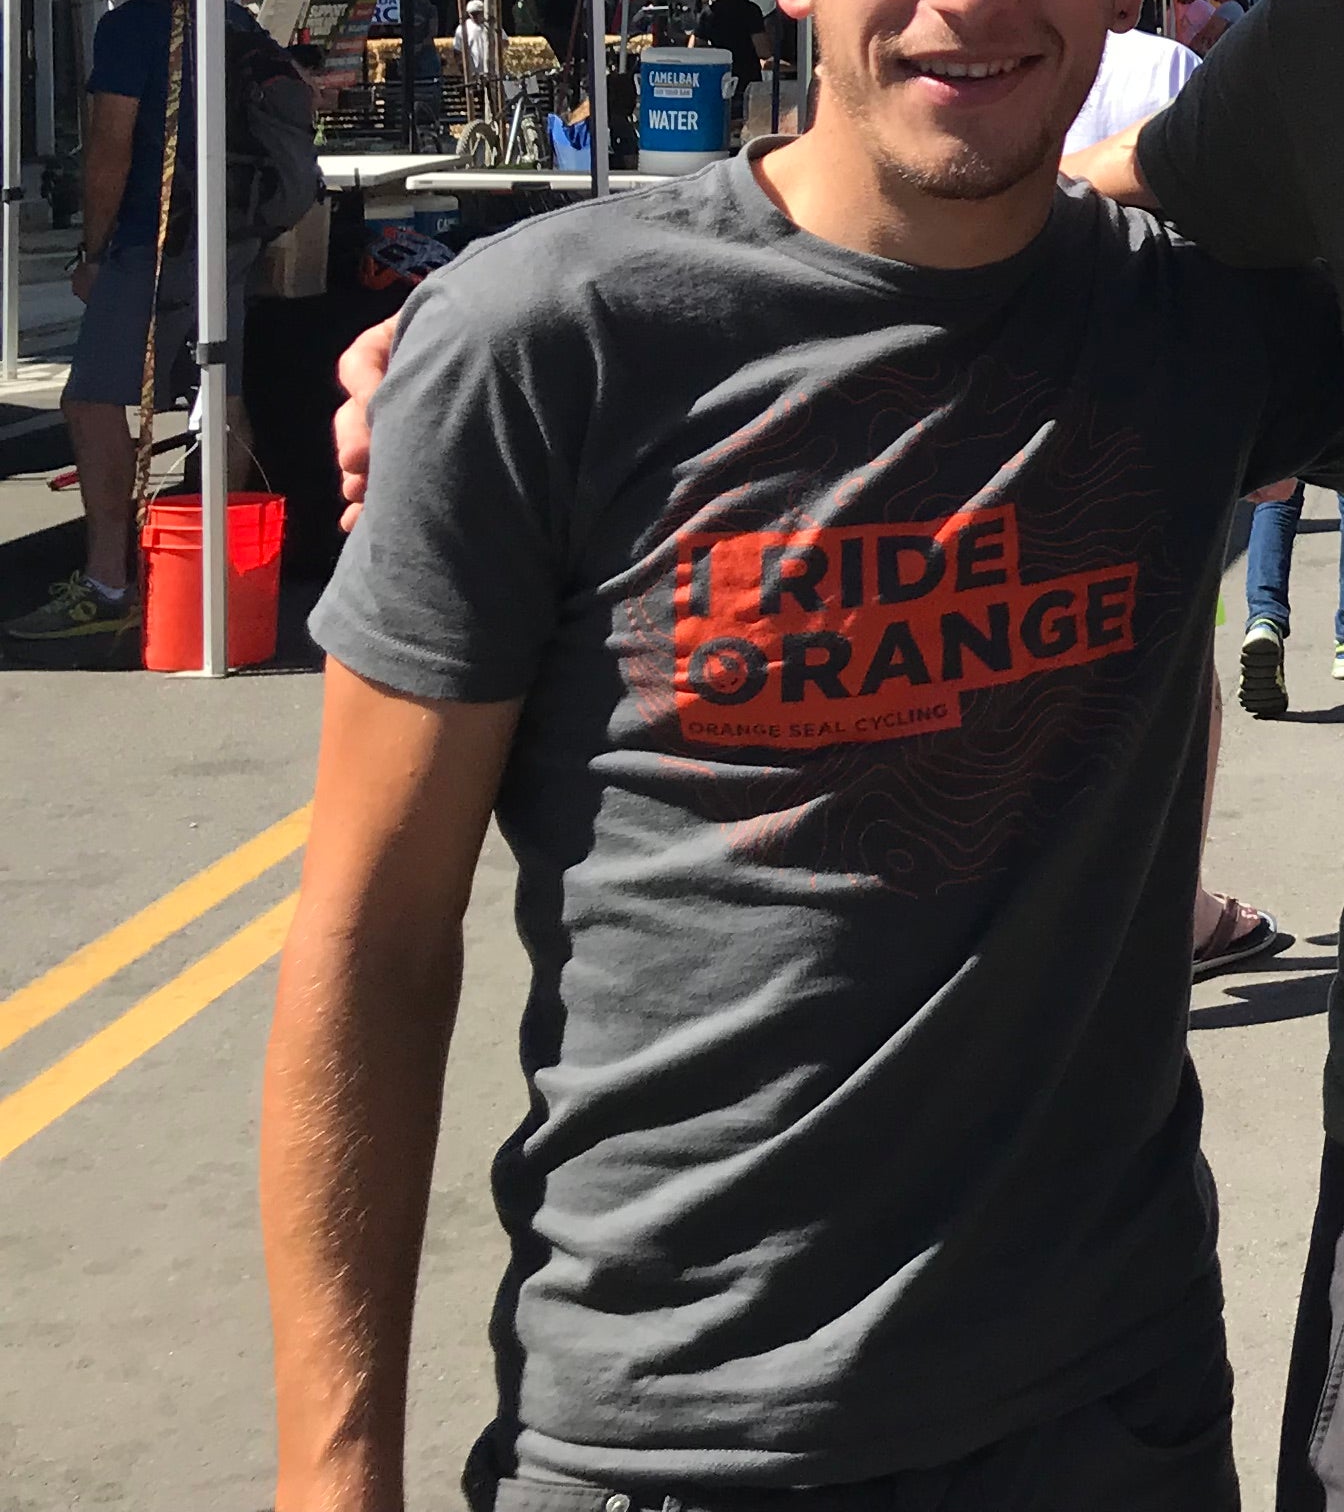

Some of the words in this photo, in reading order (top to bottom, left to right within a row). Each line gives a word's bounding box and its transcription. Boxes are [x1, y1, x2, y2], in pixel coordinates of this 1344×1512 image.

[649, 70, 700, 88] CAMELBAK
[649, 109, 699, 130] WATER
[688, 546, 714, 617] I
[759, 517, 1006, 615] RIDE
[686, 576, 1132, 705] ORANGE
[688, 721, 782, 738] ORANGE
[788, 721, 846, 738] SEAL
[854, 703, 948, 733] CYCLING
